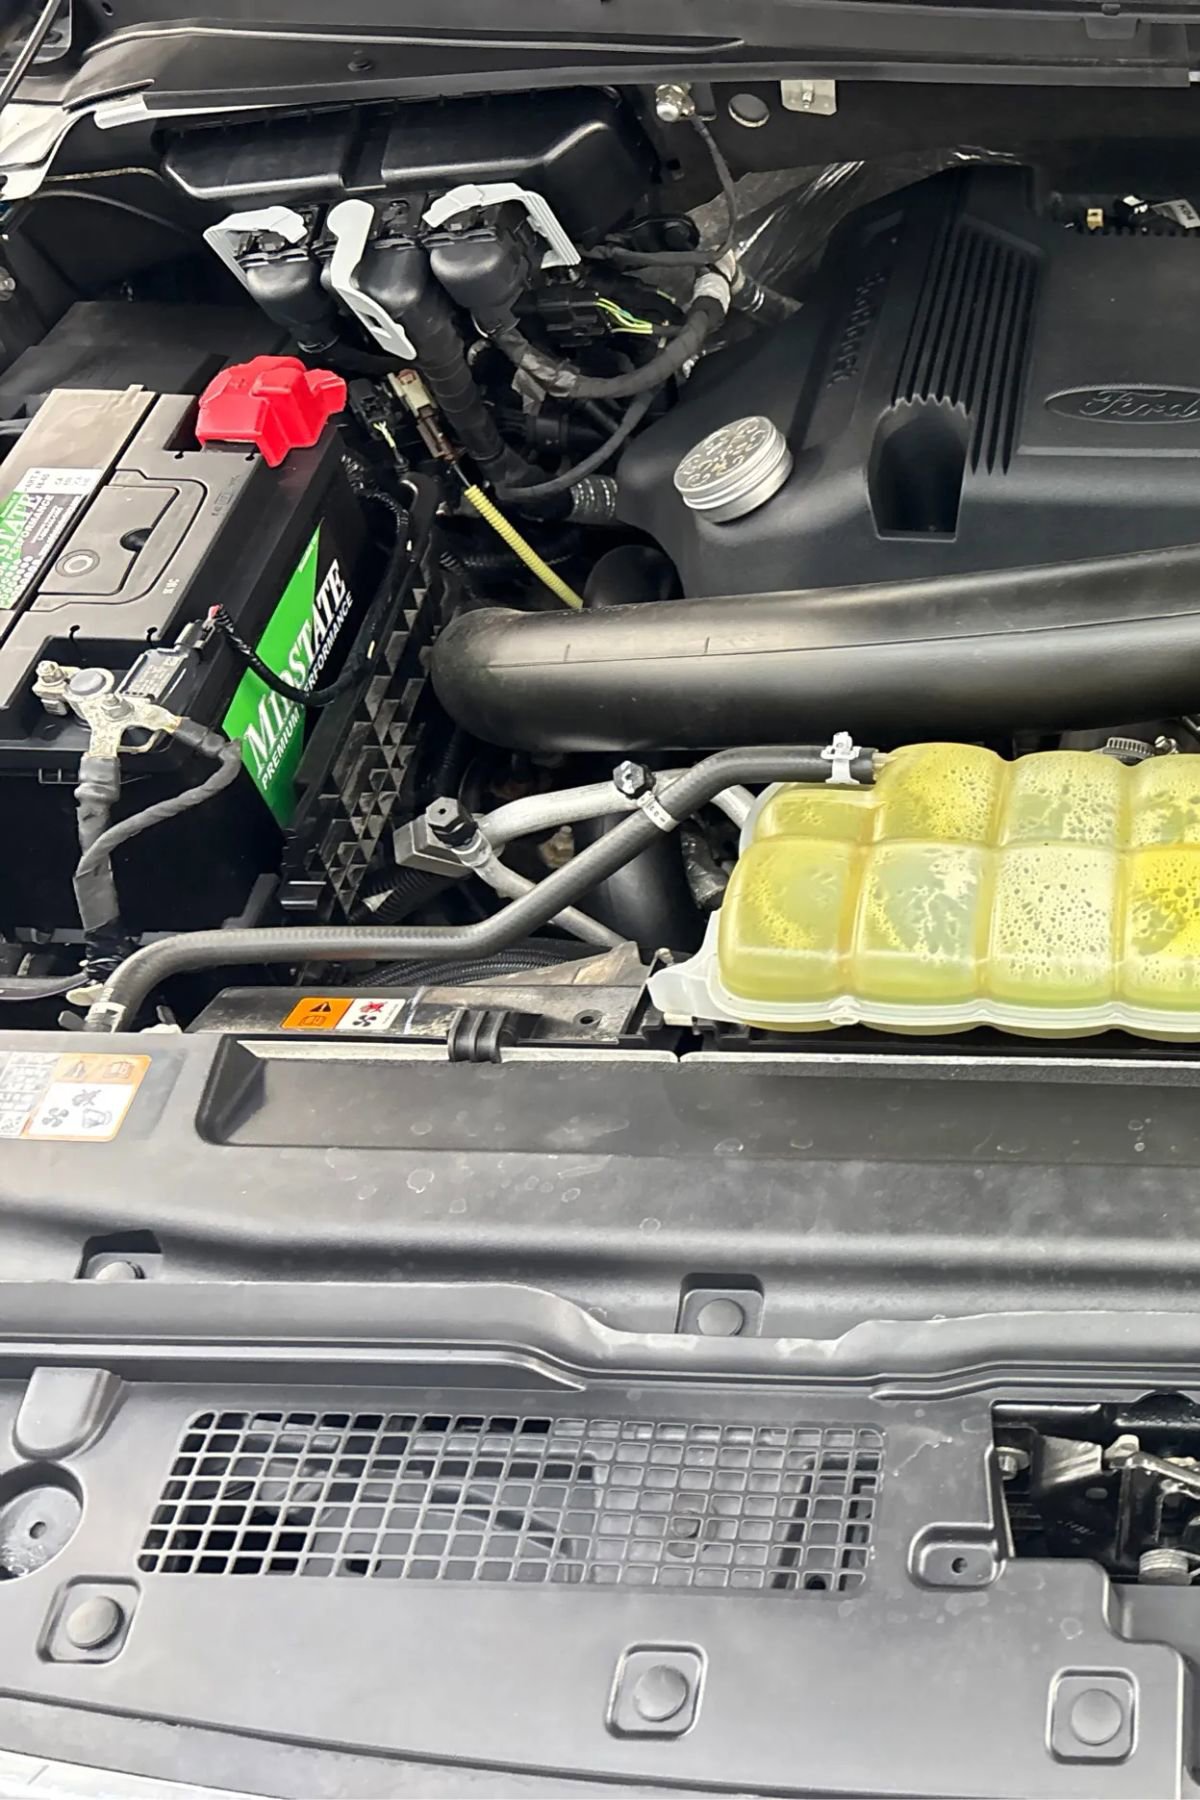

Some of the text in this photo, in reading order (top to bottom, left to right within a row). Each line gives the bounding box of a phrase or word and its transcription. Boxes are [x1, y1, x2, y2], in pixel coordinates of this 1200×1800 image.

[1079, 391, 1200, 417] Ford
[302, 590, 354, 699] ERFORMANCE
[262, 706, 300, 790] PREMIUM
